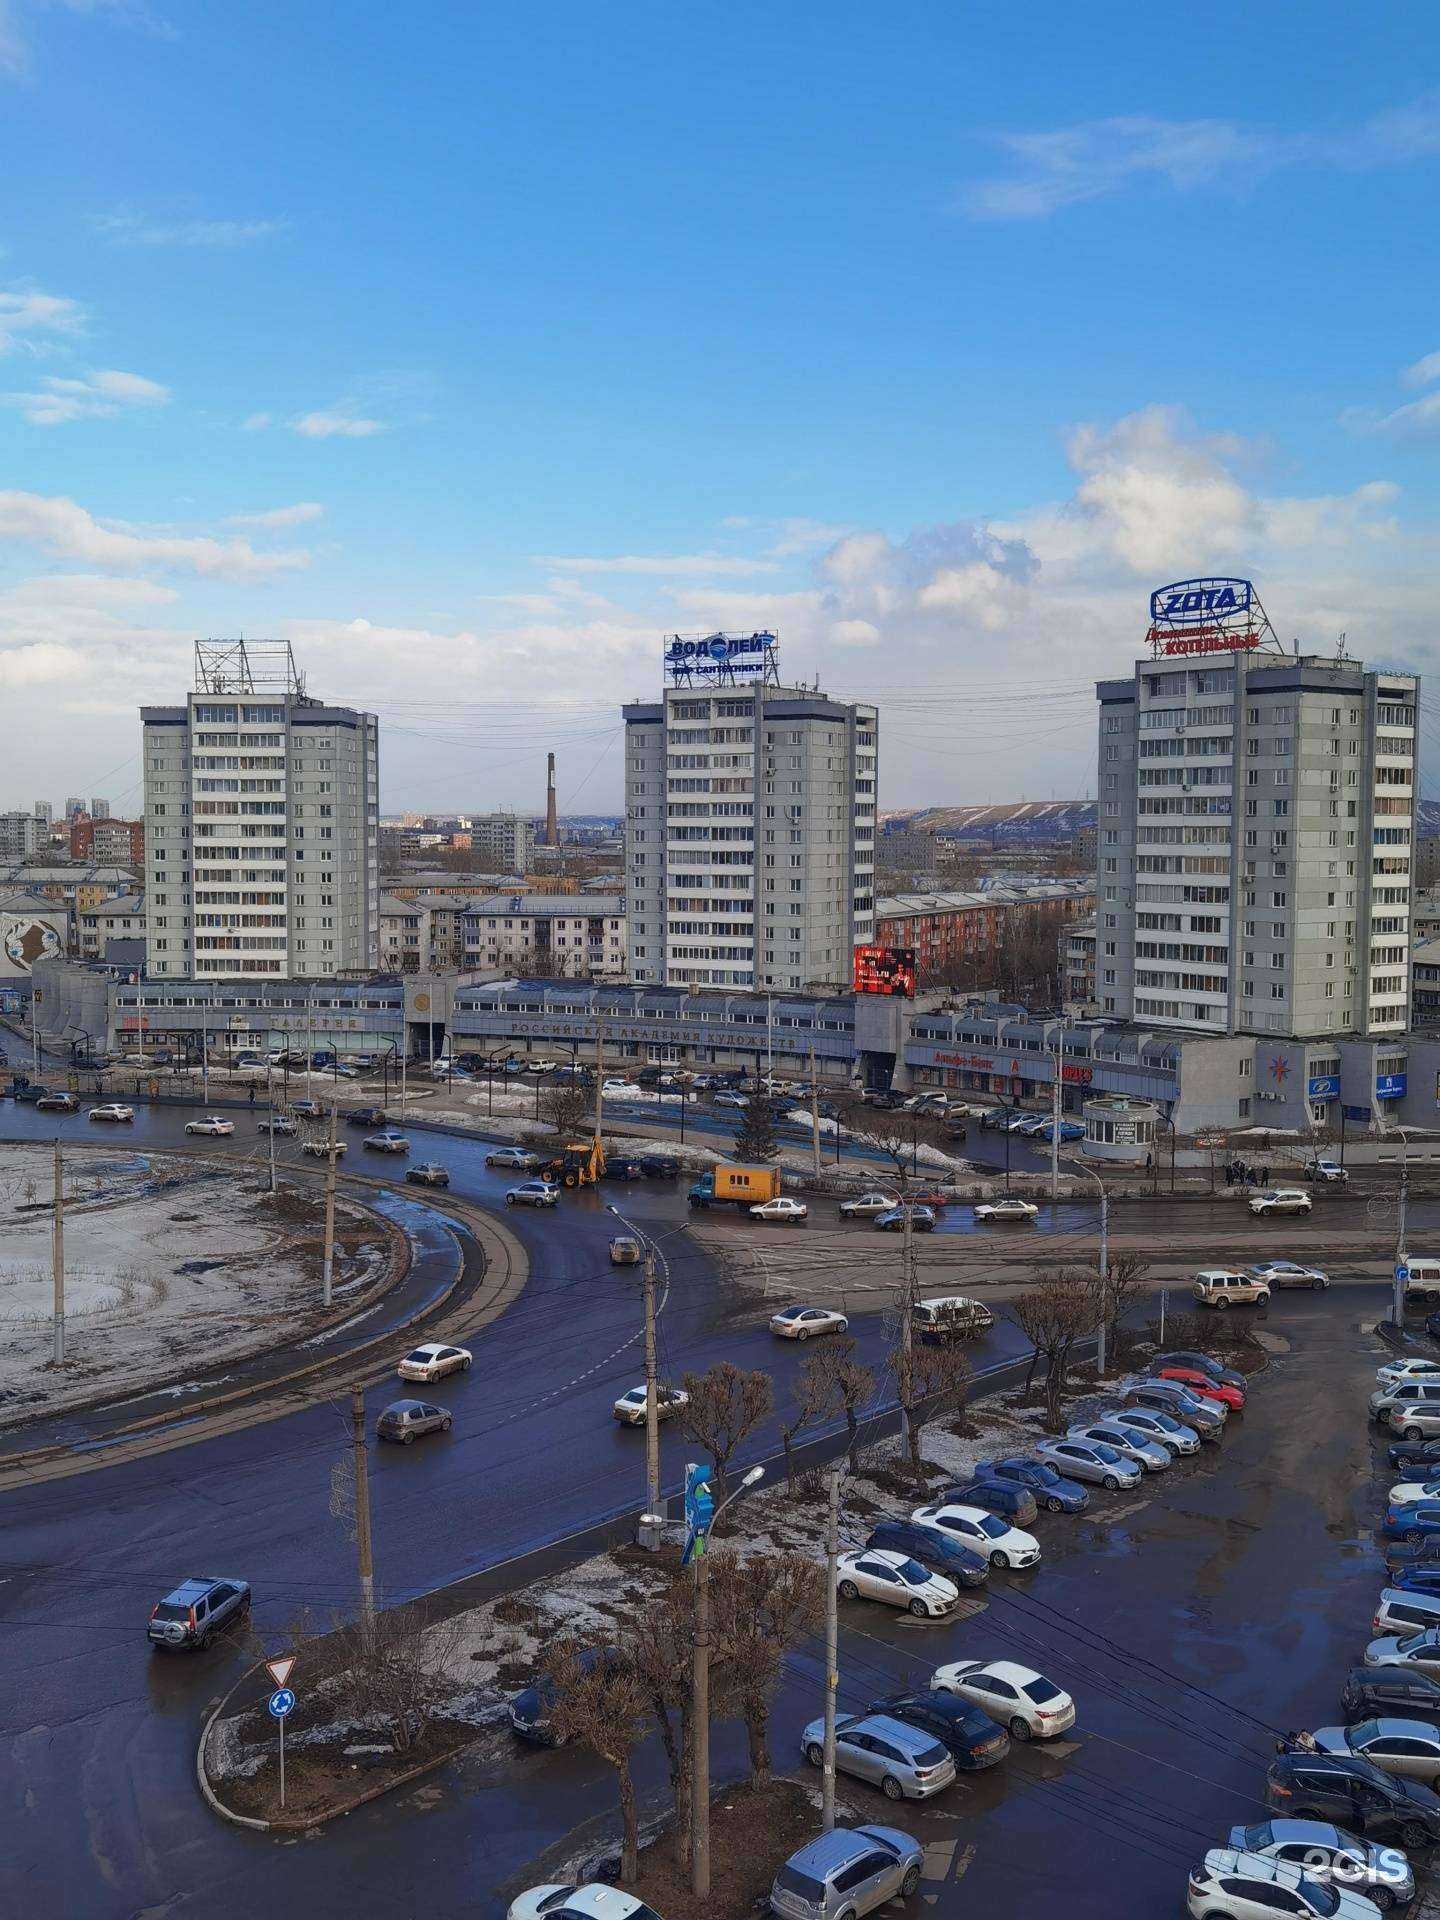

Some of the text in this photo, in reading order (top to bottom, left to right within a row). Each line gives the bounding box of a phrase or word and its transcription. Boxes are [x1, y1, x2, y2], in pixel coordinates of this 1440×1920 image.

[1164, 587, 1237, 613] ZOTA
[1165, 632, 1260, 655] КОТЕЛЬНЫЕ
[697, 663, 763, 674] САНТЕХНИКИ
[271, 1018, 360, 1029] ГАЛЕРЕЯ
[511, 1023, 796, 1048] РОССИЙСКАЯ АКАДЕМИЯ ХУДОЖЕСТВ
